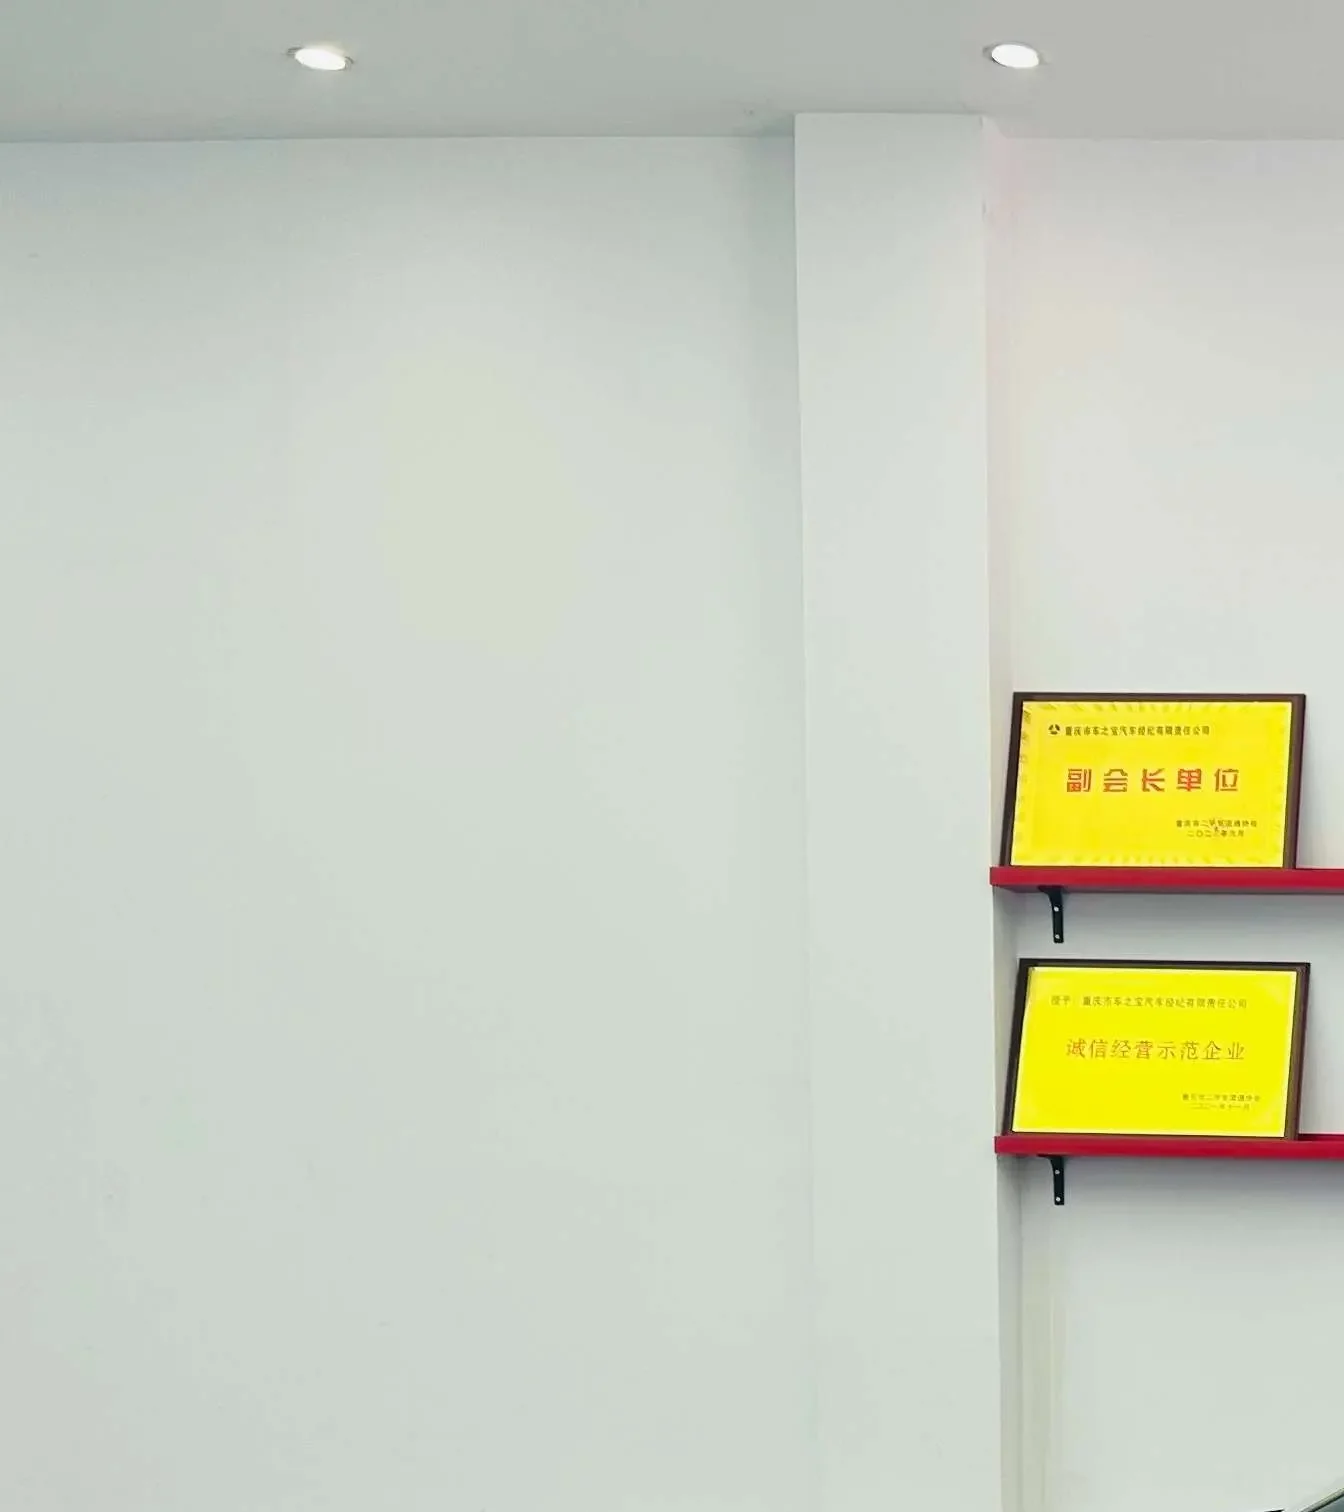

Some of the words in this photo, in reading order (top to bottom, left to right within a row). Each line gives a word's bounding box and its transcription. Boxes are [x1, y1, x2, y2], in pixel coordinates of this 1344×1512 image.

[1066, 768, 1240, 793] 副会长单位
[1066, 1037, 1246, 1061] 诚信经营示范企业
